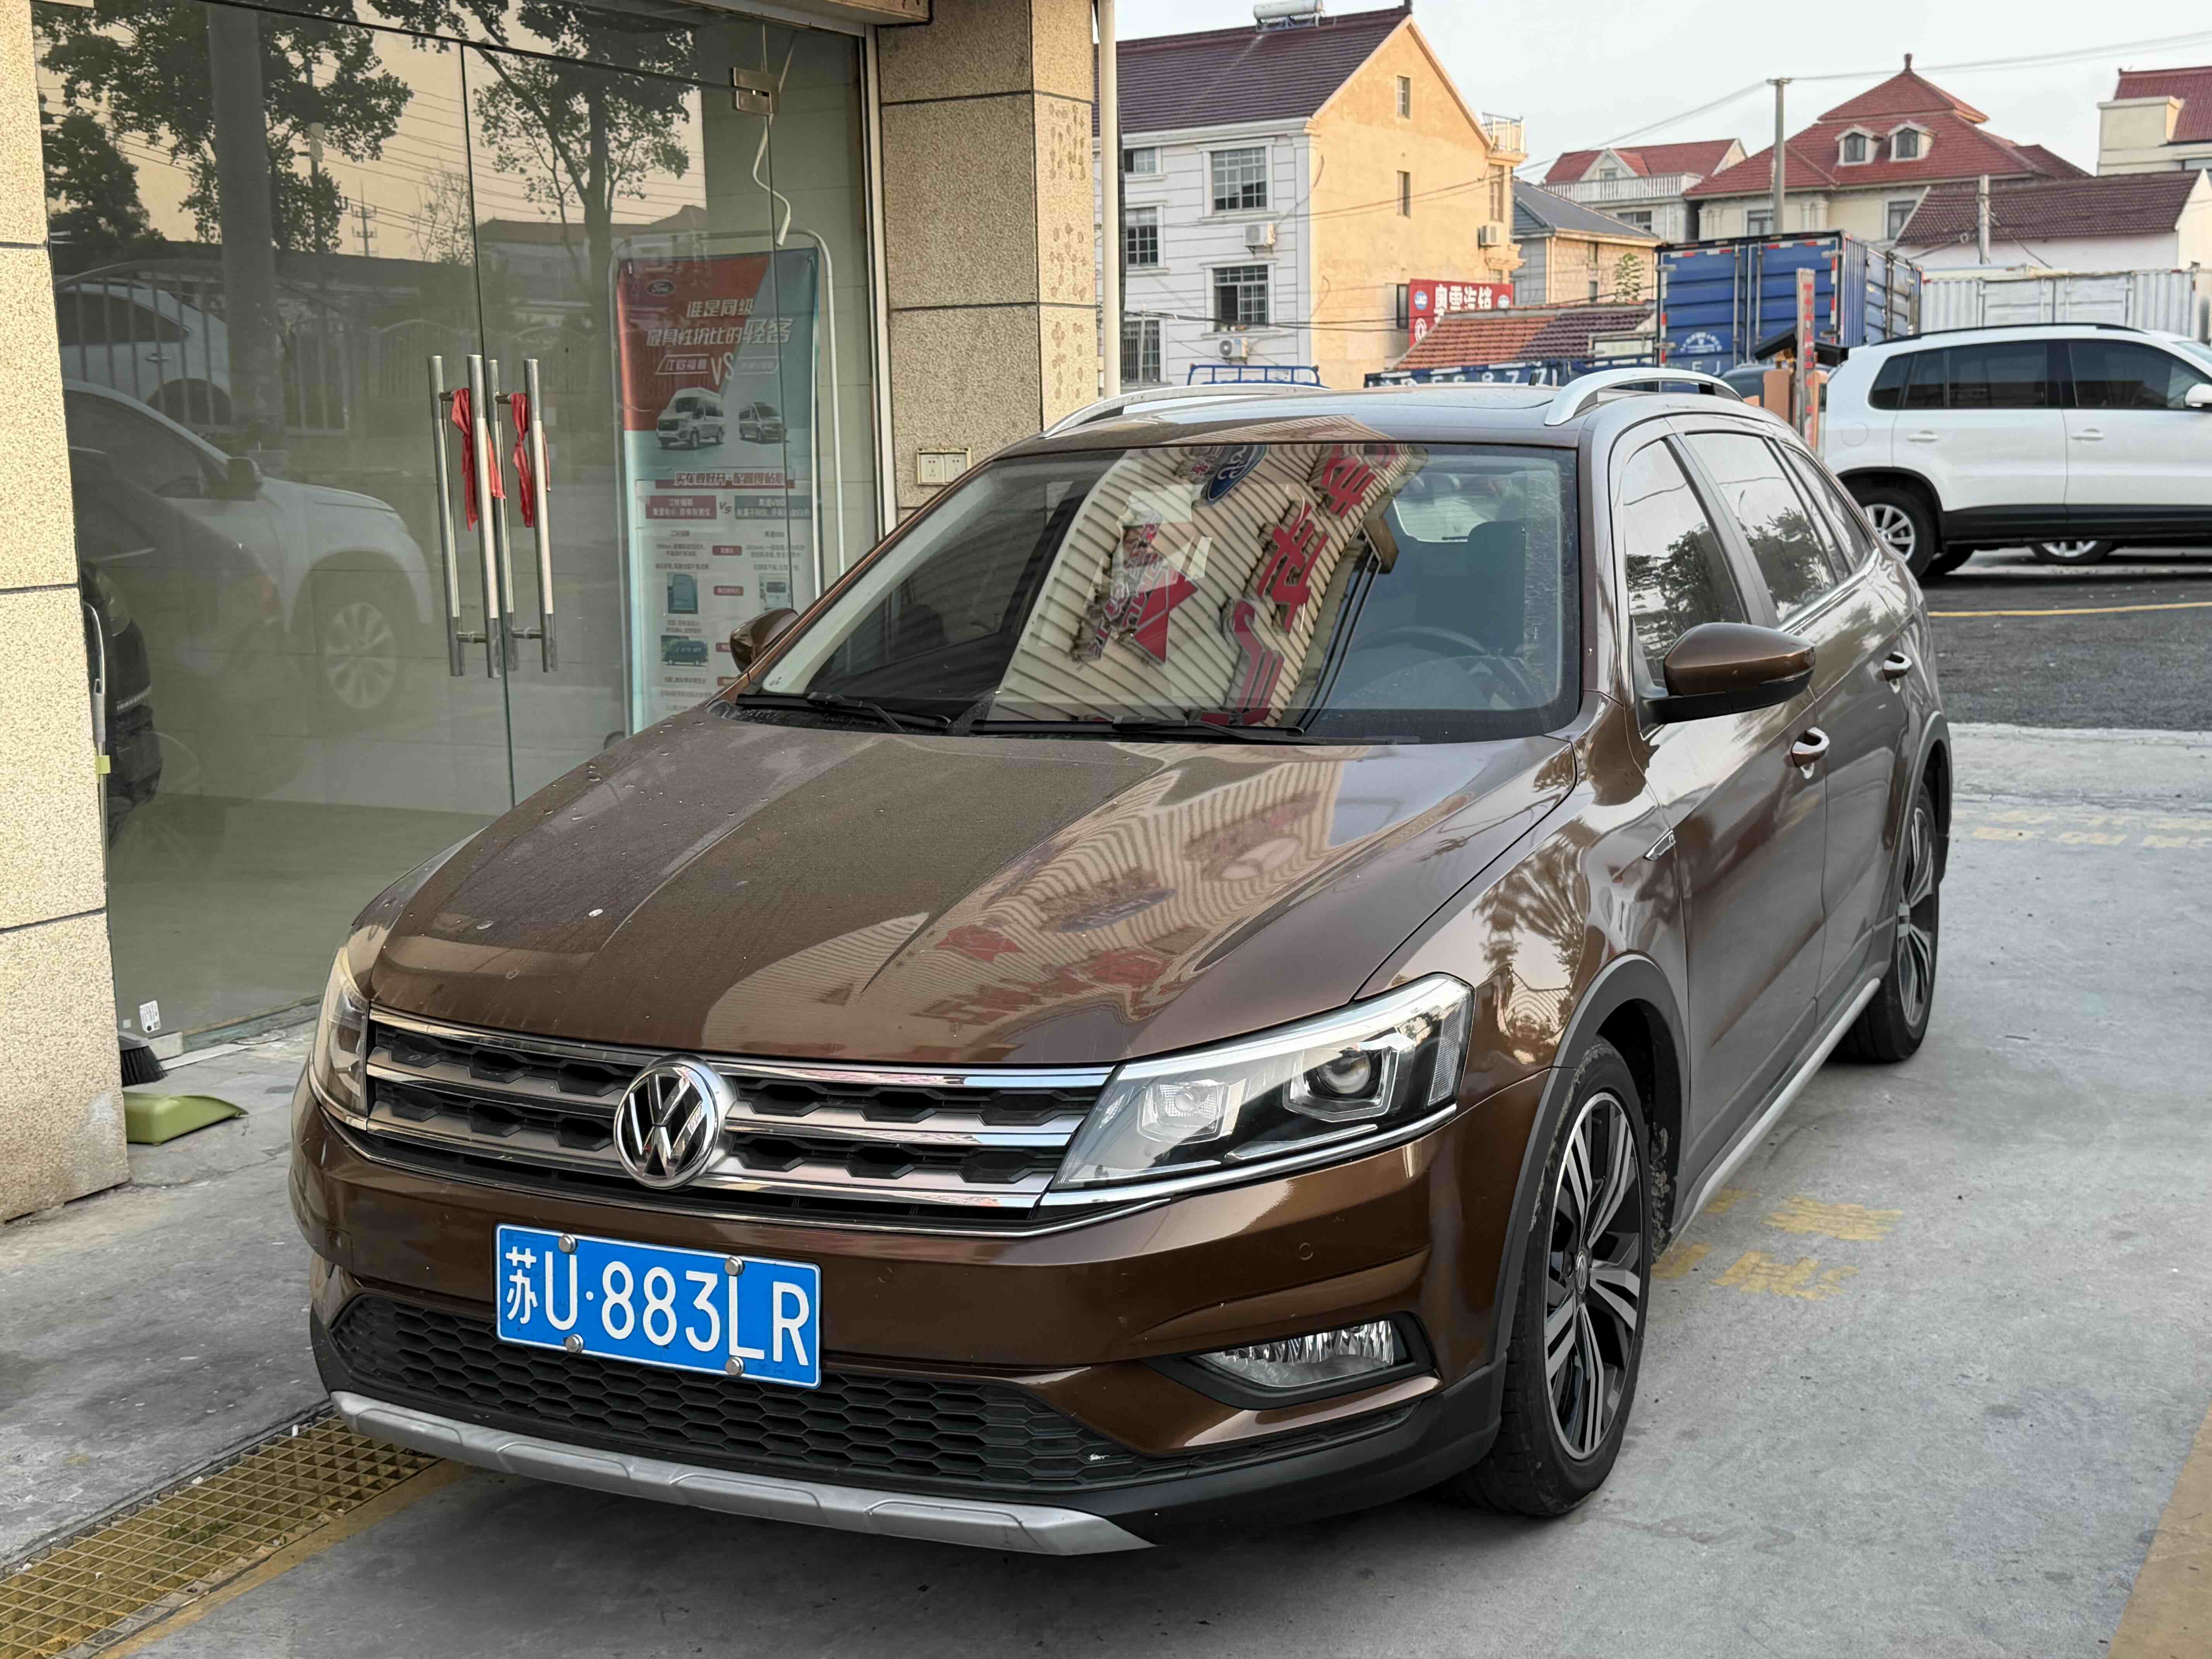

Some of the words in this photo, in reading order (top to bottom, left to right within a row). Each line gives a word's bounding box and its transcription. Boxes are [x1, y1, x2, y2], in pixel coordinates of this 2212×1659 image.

[687, 299, 755, 318] 谁是同级
[646, 318, 793, 347] 最具性价比的轻客
[711, 351, 735, 385] VS
[719, 501, 732, 514] VS
[505, 1245, 810, 1366] 苏U·883LR
